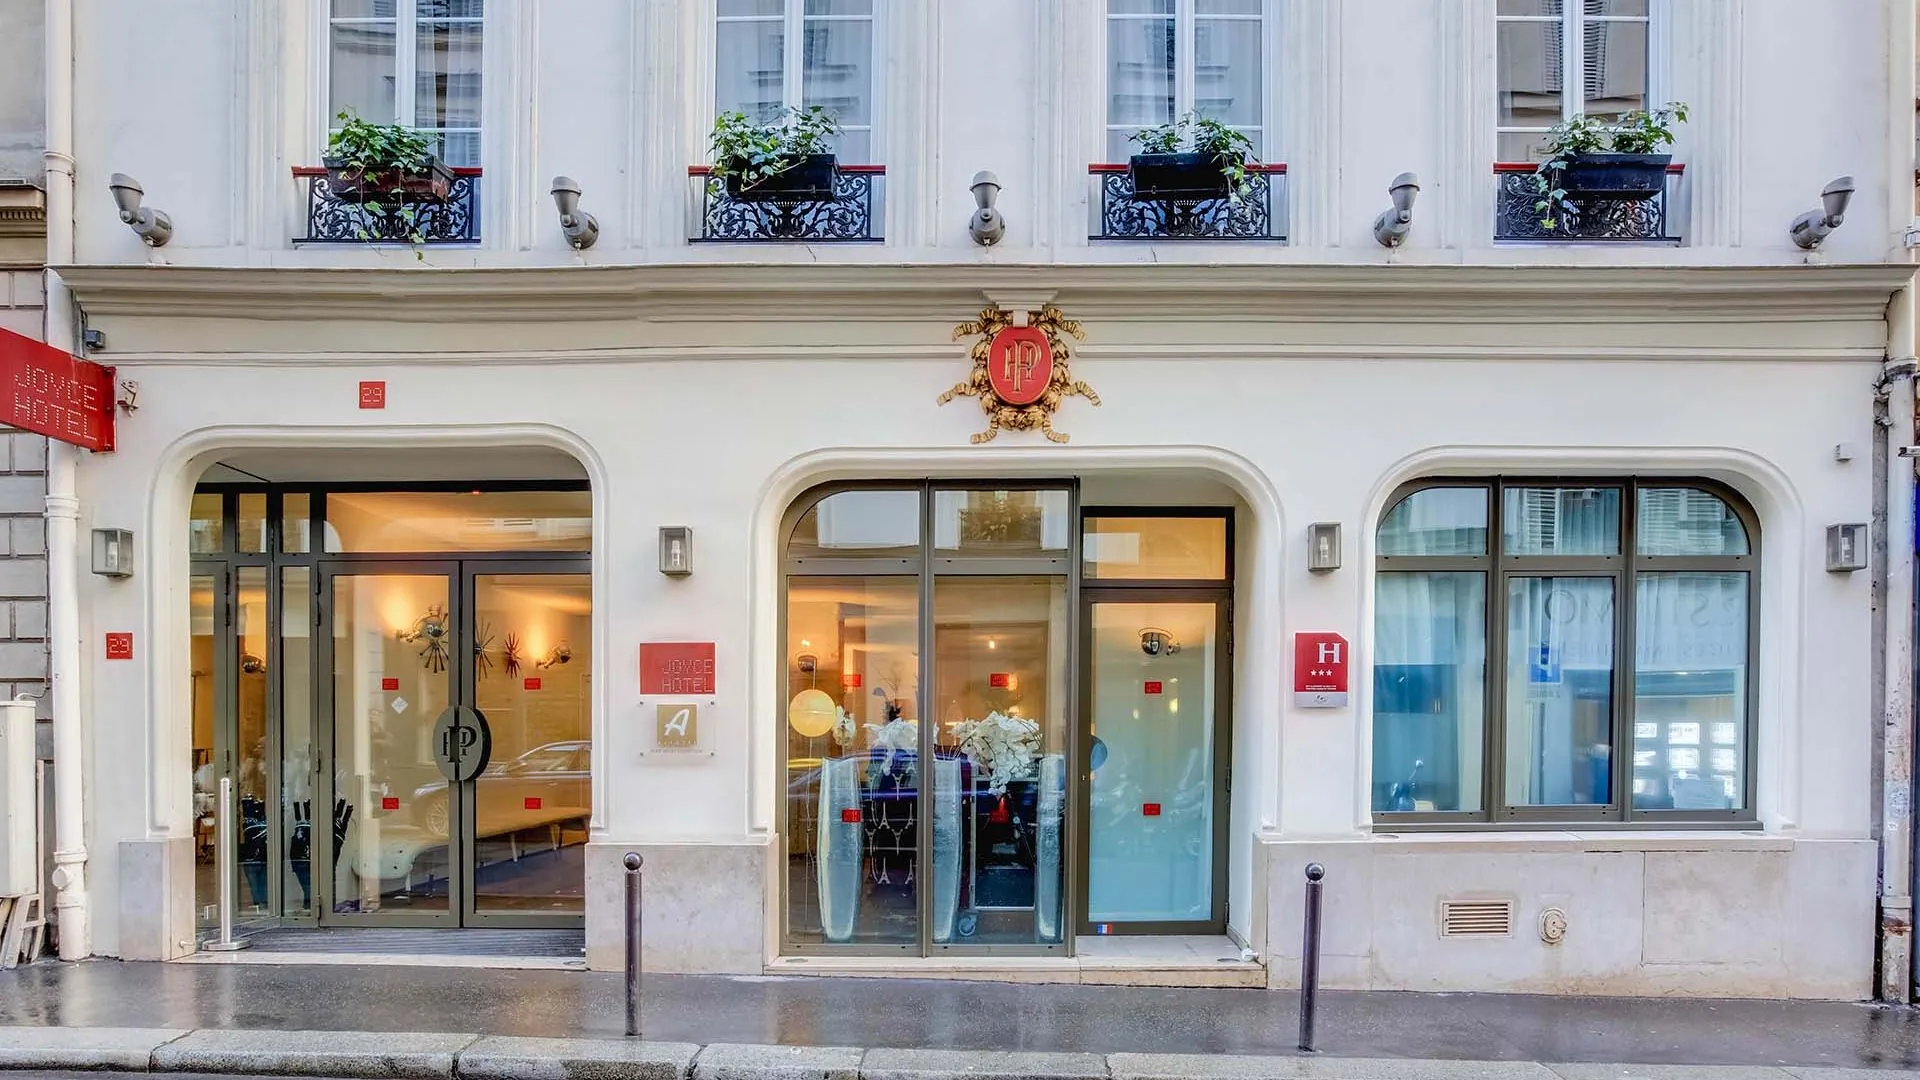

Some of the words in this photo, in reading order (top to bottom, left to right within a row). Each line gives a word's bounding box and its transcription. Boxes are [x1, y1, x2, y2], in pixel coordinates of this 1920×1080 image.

[15, 364, 98, 412] JOYCE
[362, 387, 382, 403] 29
[15, 392, 98, 442] HOTEL
[109, 638, 130, 653] 29
[1317, 642, 1342, 664] H
[661, 659, 713, 674] JOYCE
[661, 677, 713, 693] HOTEL
[664, 708, 690, 737] A
